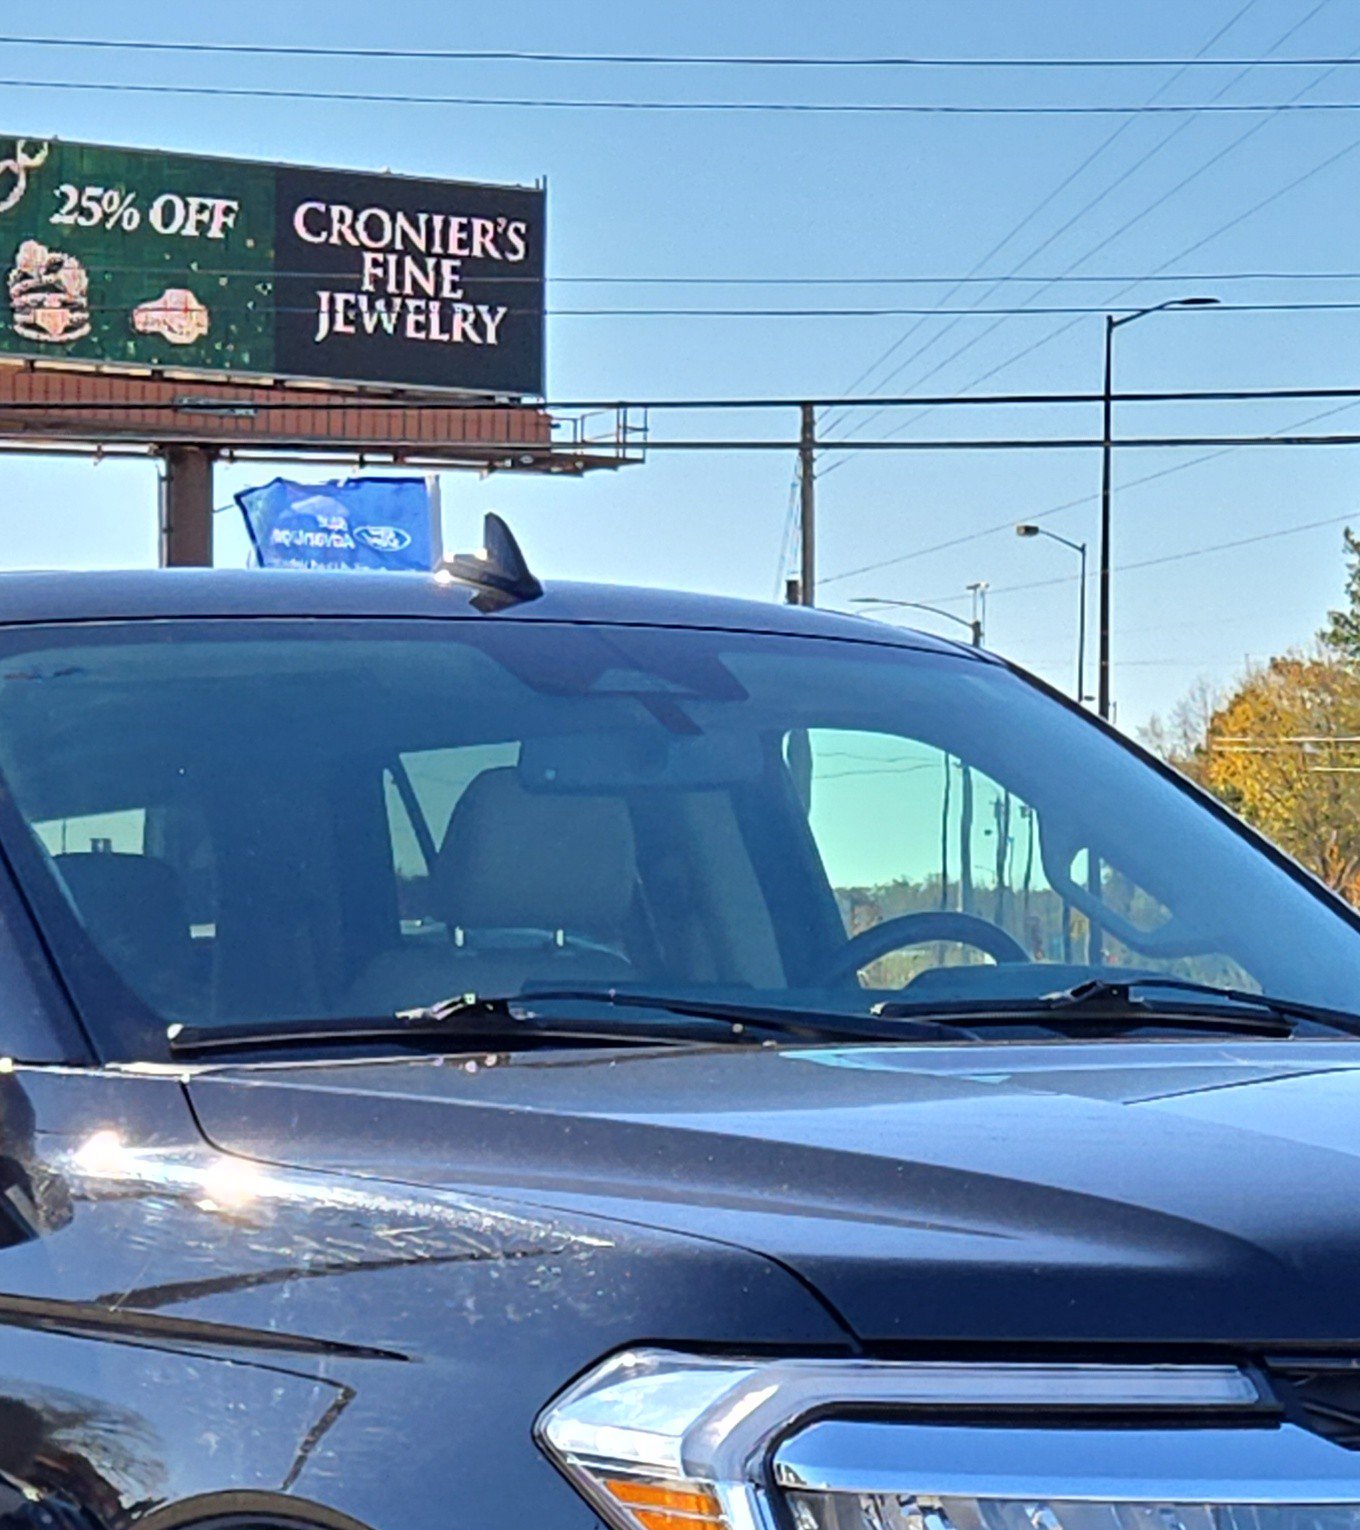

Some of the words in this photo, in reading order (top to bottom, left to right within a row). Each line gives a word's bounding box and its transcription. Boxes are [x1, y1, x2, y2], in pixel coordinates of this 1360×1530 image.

[49, 183, 141, 232] 25%
[148, 193, 240, 239] OFF
[292, 200, 528, 262] CRONIER'S
[360, 251, 465, 300] FINE
[314, 290, 509, 345] JEWELRY
